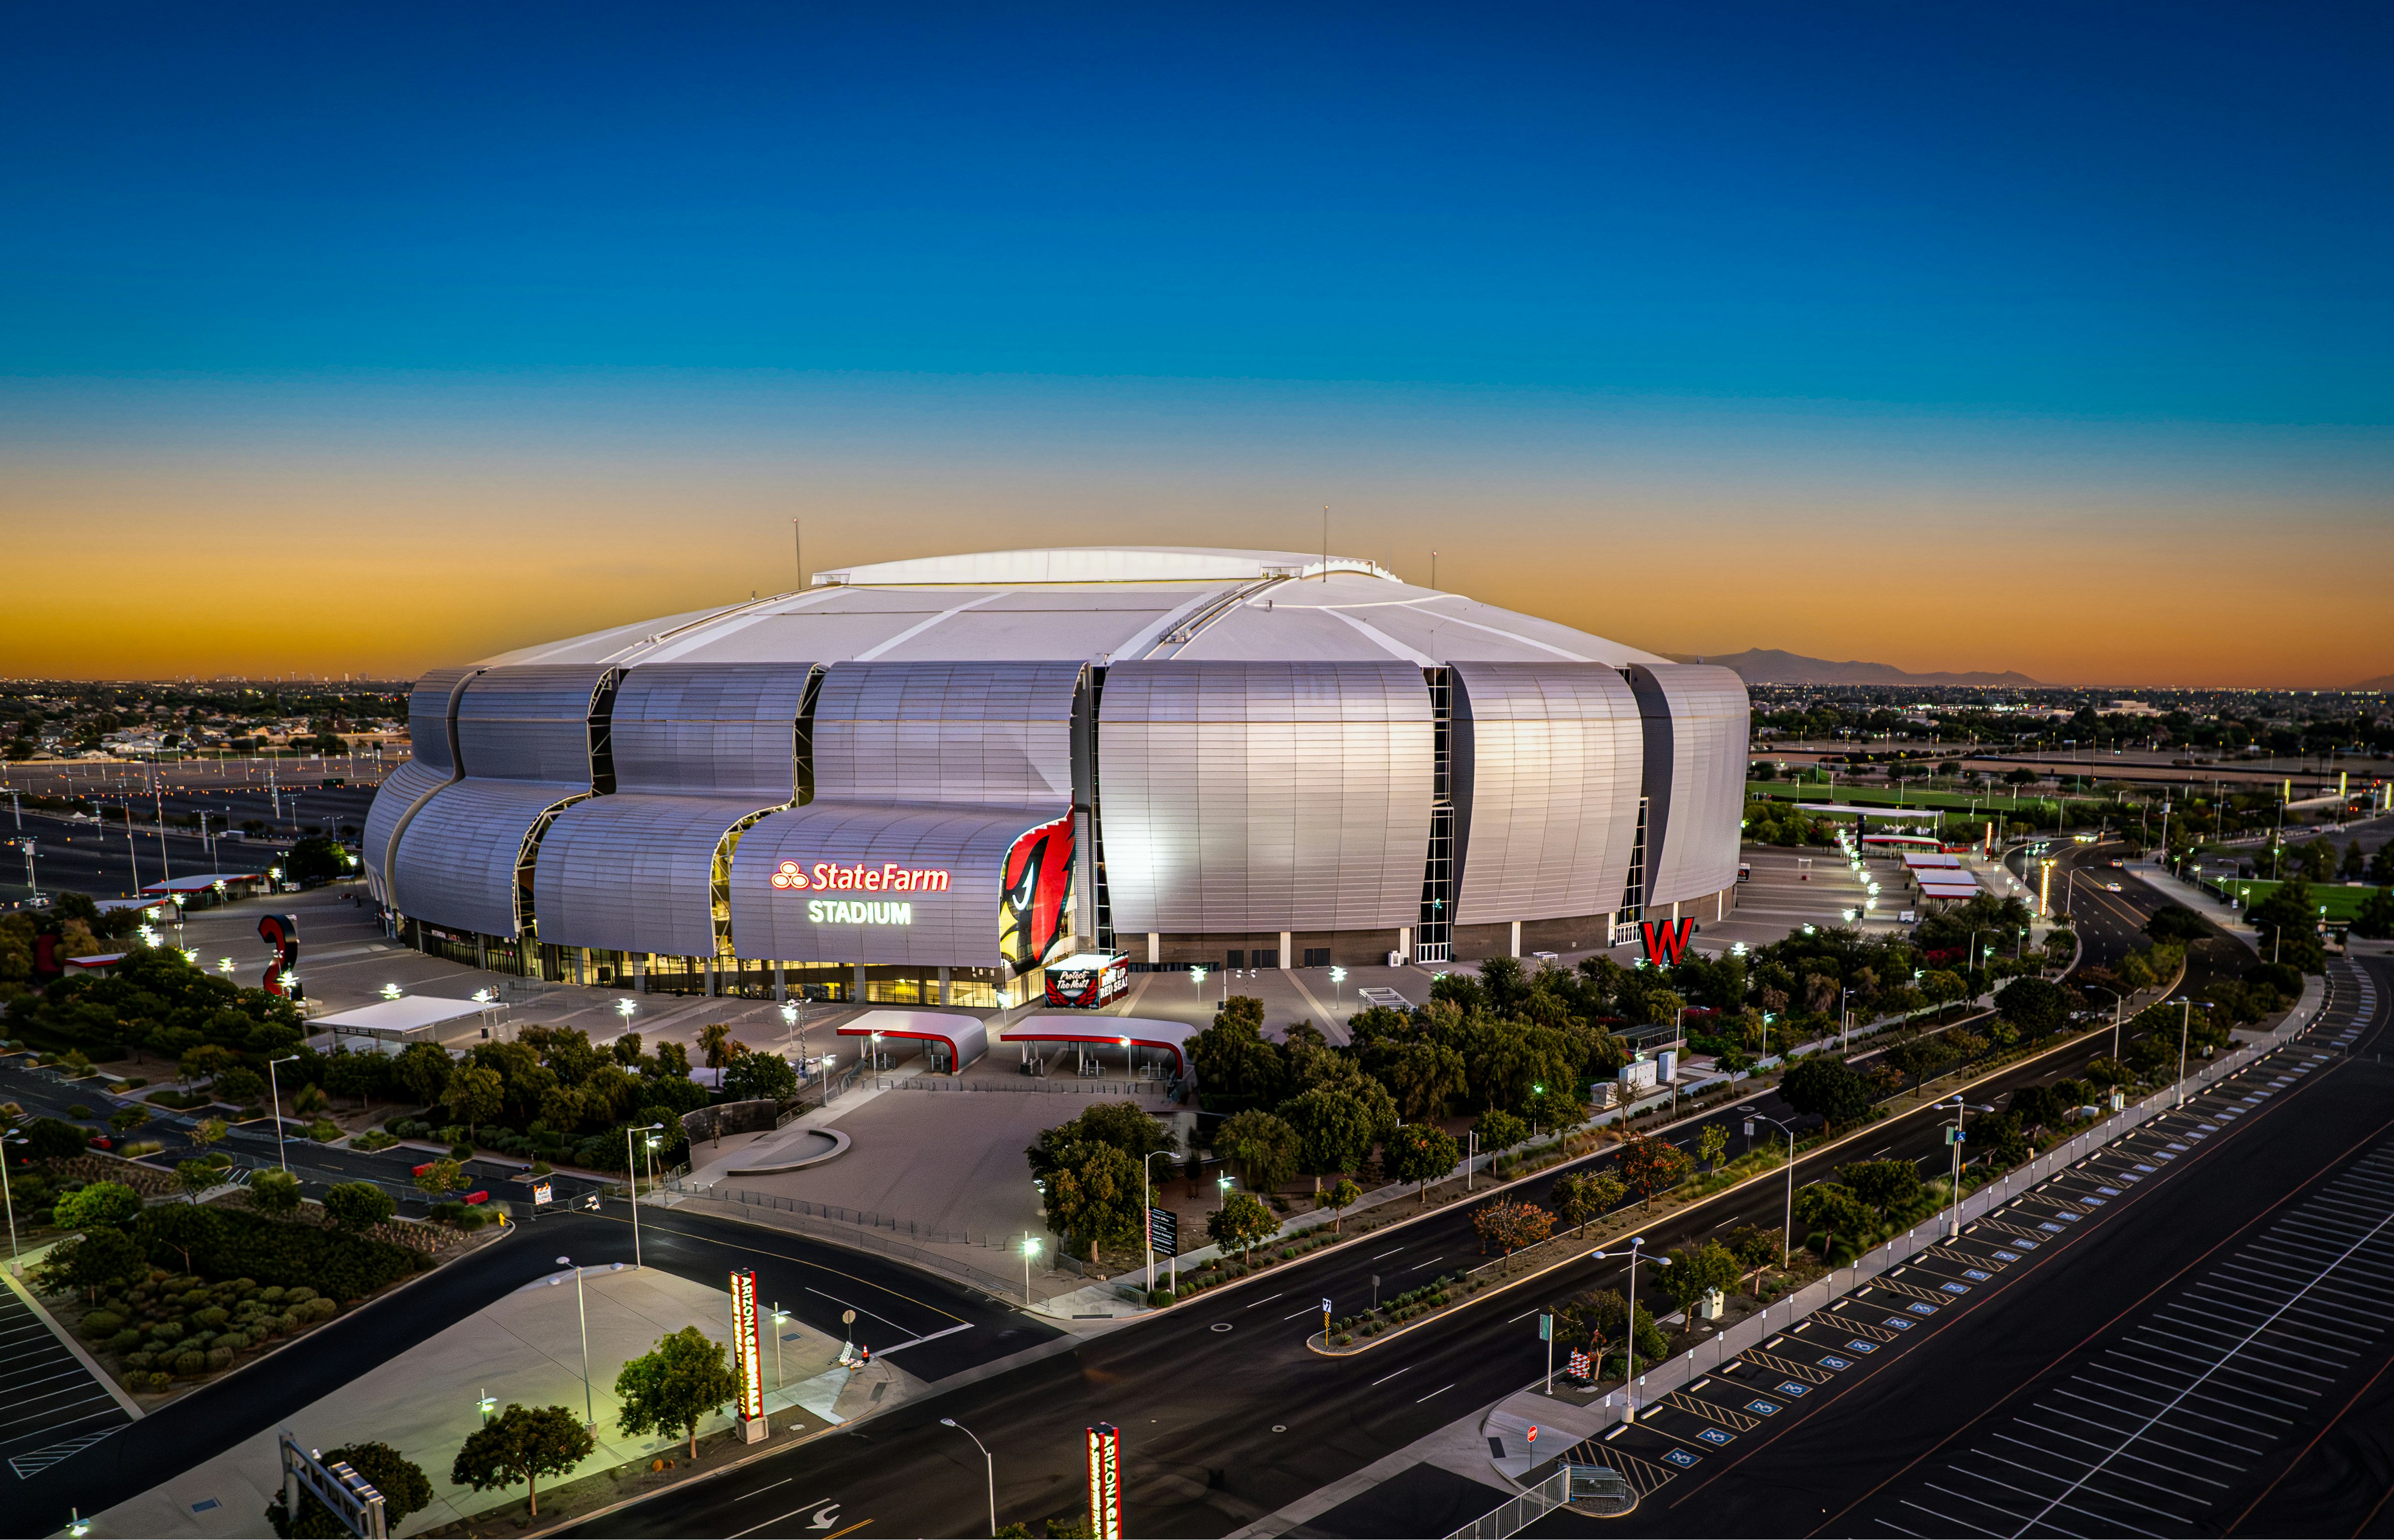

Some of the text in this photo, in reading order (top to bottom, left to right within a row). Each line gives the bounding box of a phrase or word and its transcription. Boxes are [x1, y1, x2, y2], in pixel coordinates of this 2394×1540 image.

[809, 900, 911, 924] STADIUM
[1639, 916, 1695, 967] W
[1059, 970, 1090, 980] Protect
[1117, 967, 1126, 979] UP
[1100, 976, 1128, 999] RED SEA!
[741, 1277, 760, 1416] ARIZONA CARDINALS
[1528, 1429, 1537, 1438] STOP
[1104, 1436, 1117, 1508] ARIZONA
